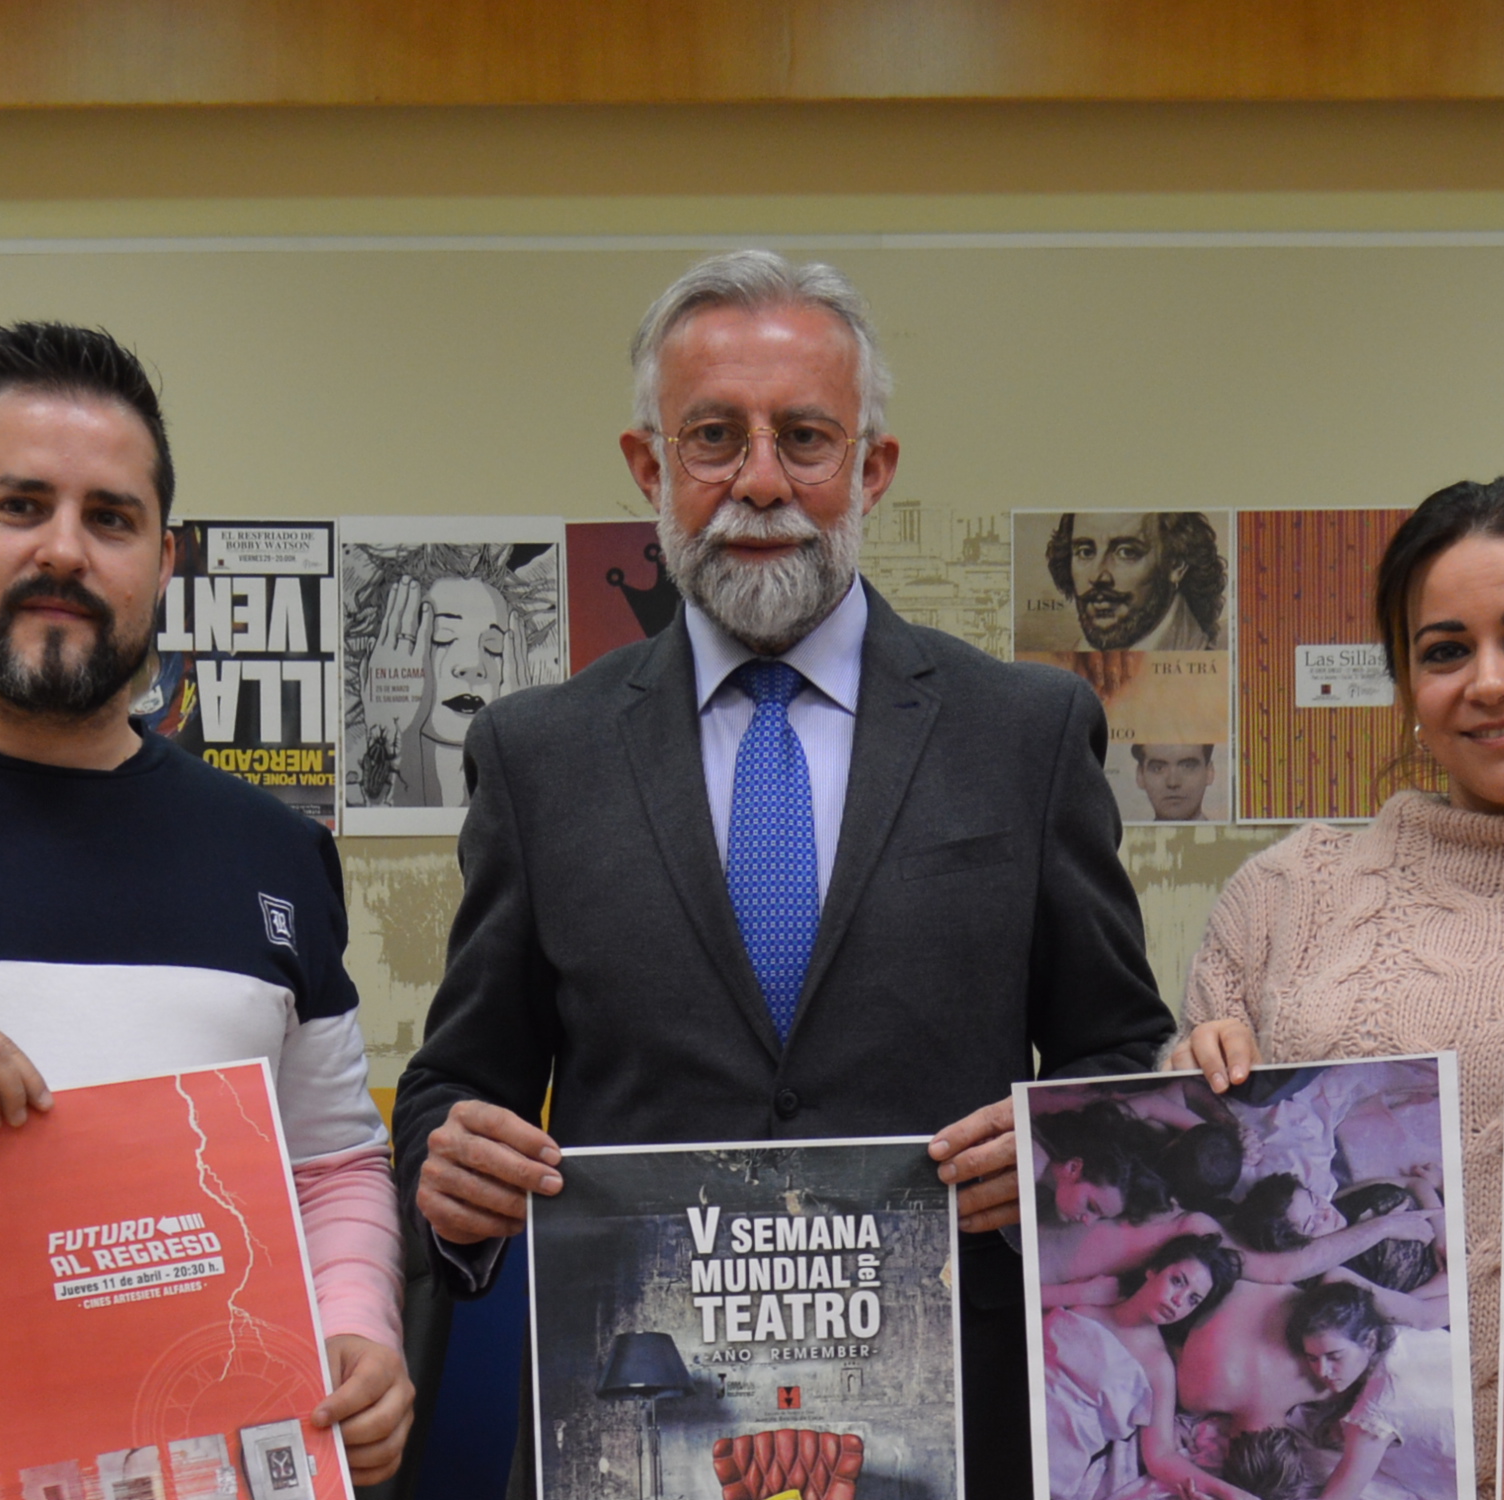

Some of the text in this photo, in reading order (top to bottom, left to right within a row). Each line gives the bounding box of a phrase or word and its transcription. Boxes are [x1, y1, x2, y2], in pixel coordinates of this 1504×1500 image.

[221, 532, 315, 540] EL RESFRIADO DE
[226, 541, 310, 550] BOBBY WATSON
[375, 667, 426, 679] EN LA CAMA
[1152, 659, 1218, 674] TRÁ TRÁ
[1305, 650, 1387, 667] Las Sillas
[48, 1216, 156, 1255] FUTURO
[686, 1206, 881, 1254] V SEMANA
[50, 1231, 223, 1278] AL REGRESO
[857, 1253, 882, 1288] del
[60, 1261, 220, 1298] Jueves 11 de abril 20:30 h.
[691, 1255, 851, 1293] MUNDIAL
[82, 1280, 204, 1310] CINES ARTESIETE ALFARES
[693, 1289, 882, 1344] TEATRO
